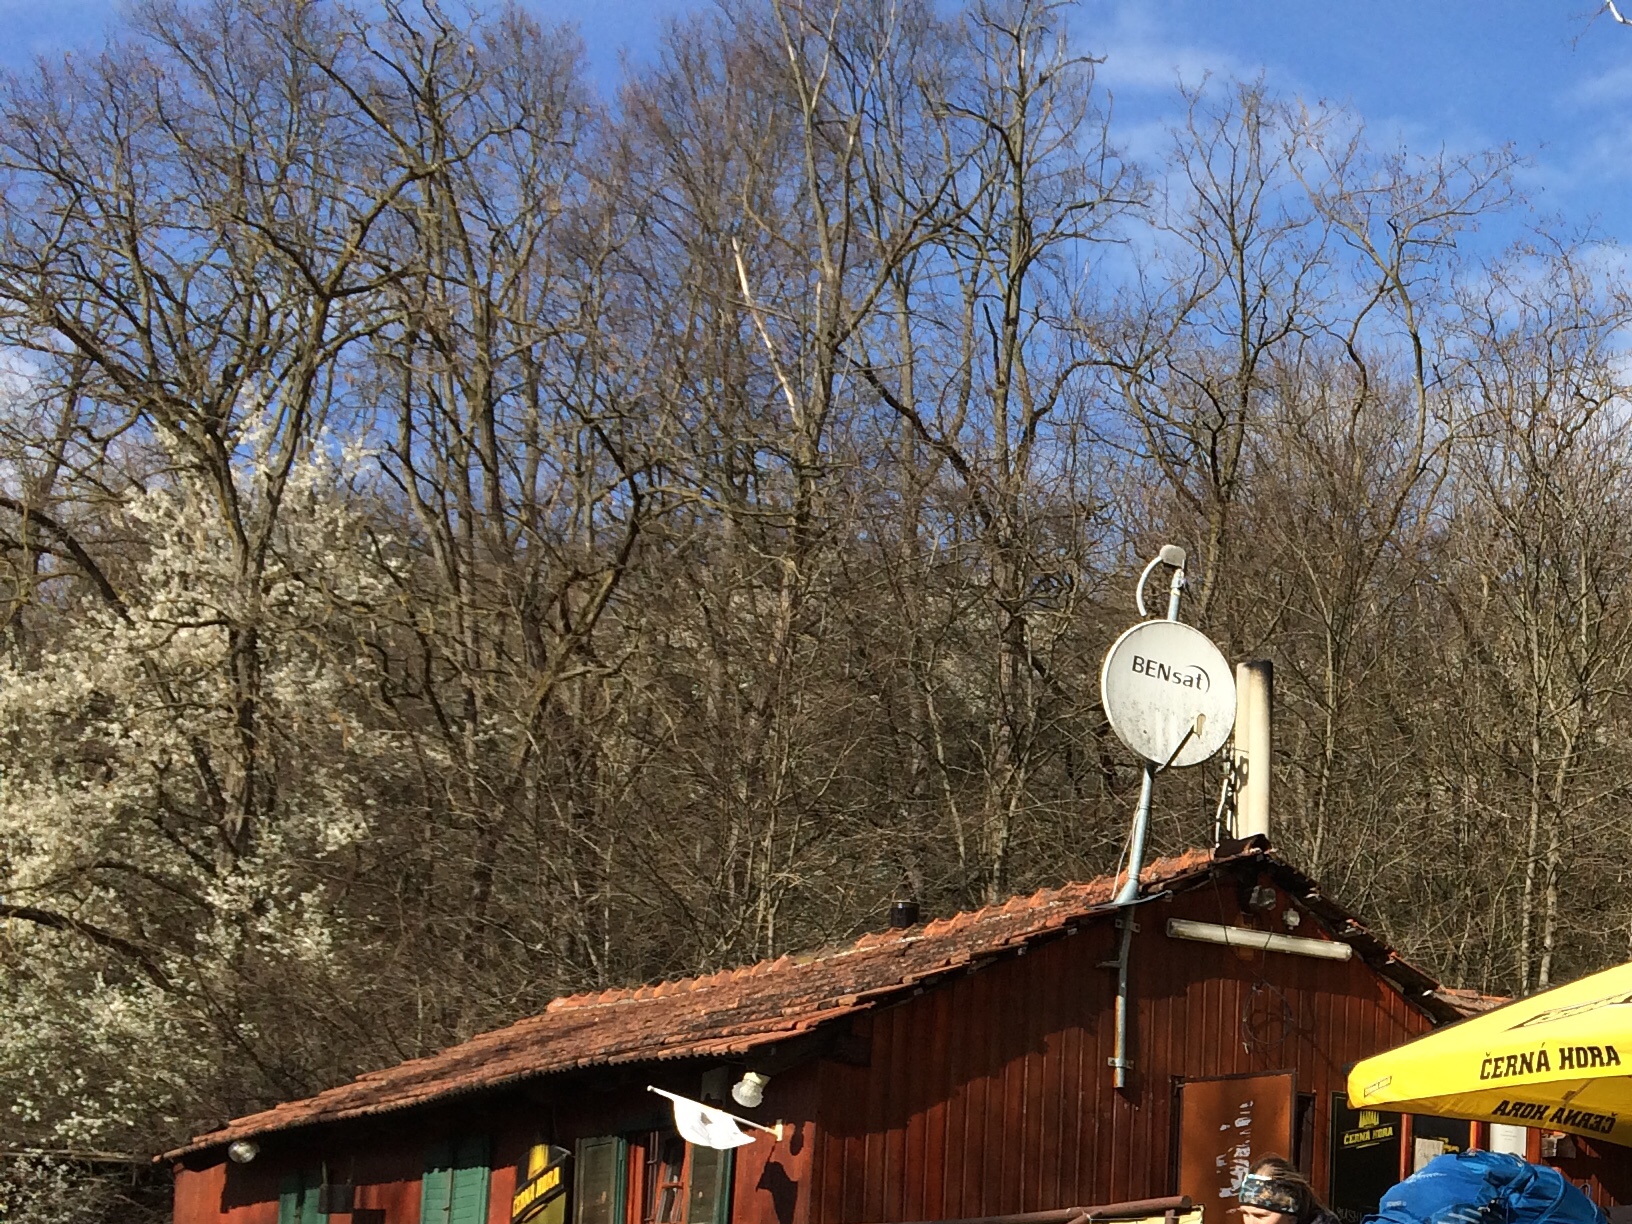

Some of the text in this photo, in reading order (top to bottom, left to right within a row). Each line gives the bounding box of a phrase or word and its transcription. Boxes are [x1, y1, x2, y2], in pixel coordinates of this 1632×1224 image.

[1131, 655, 1205, 691] BENsat
[1480, 1042, 1622, 1080] ČERNÁ HORA
[1343, 1129, 1371, 1145] ČERNÁ
